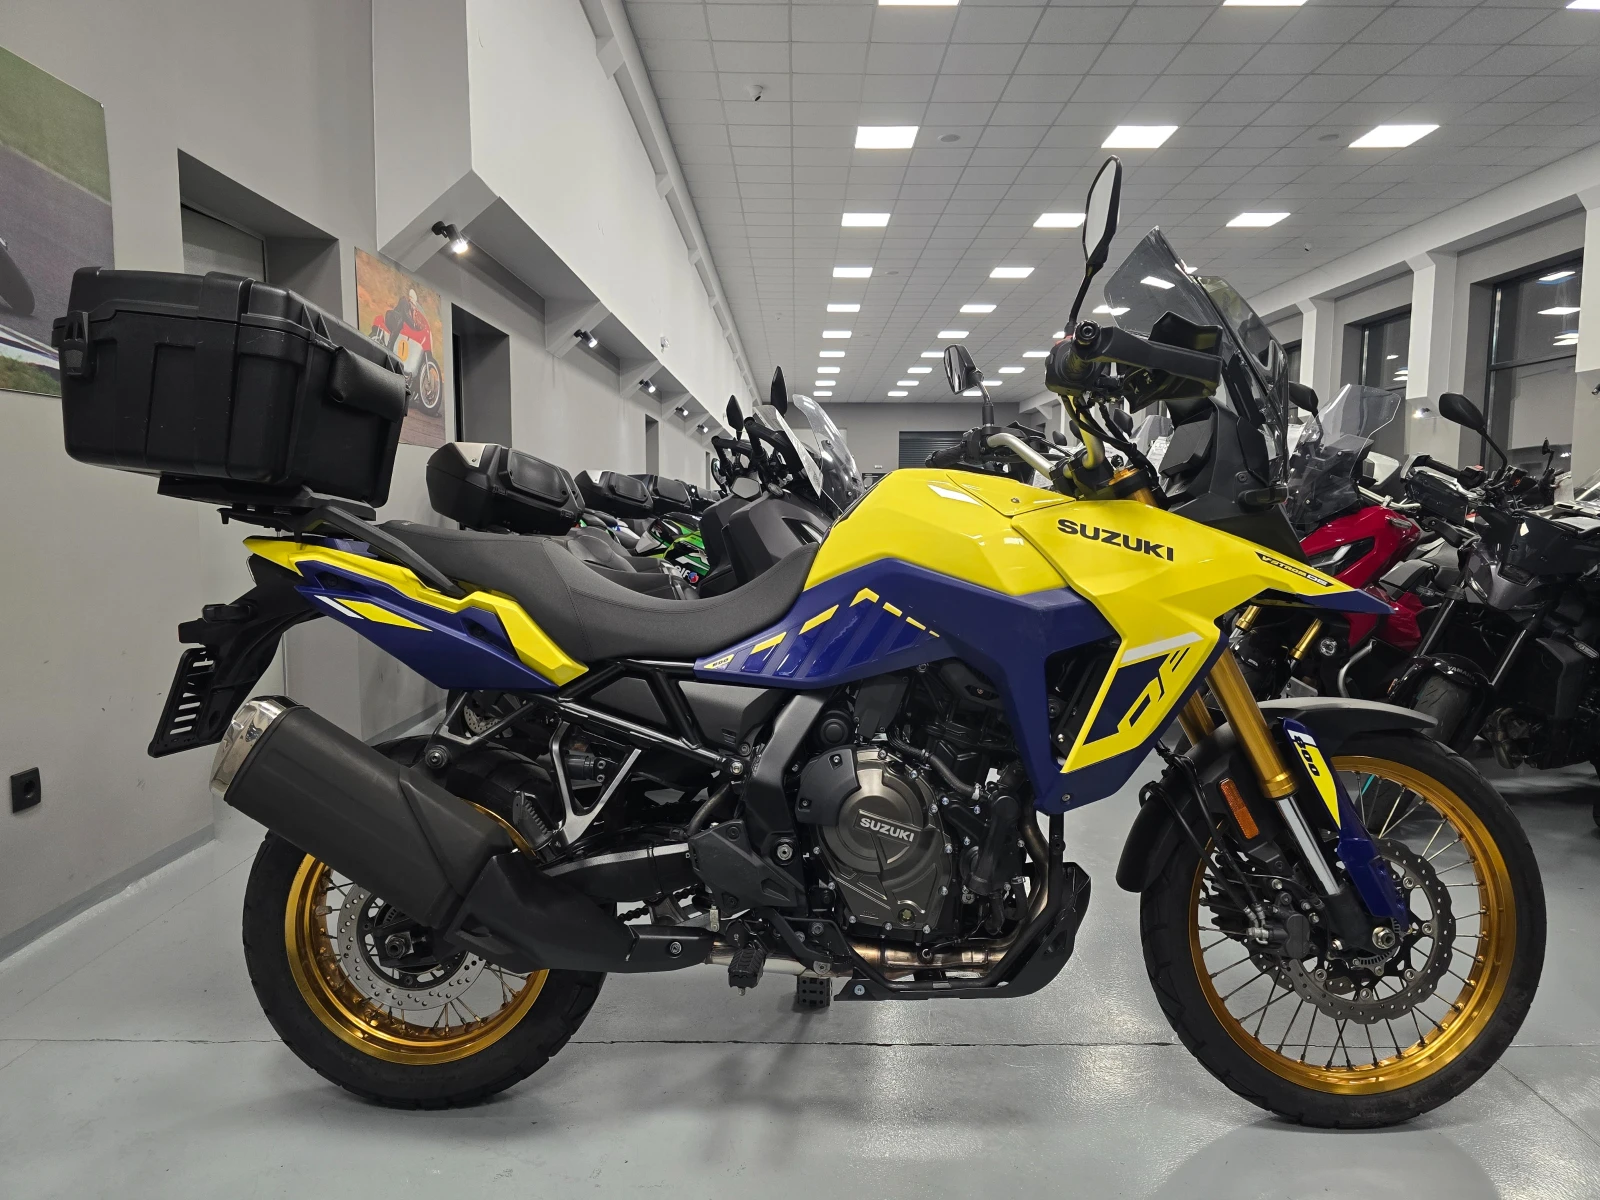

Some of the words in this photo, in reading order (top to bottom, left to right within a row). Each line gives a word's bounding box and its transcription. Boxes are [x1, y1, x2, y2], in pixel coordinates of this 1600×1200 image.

[1057, 518, 1174, 562] SUZUKI
[1447, 665, 1475, 681] YAMAHA
[1293, 735, 1320, 776] 800
[860, 817, 915, 842] SUZUKI
